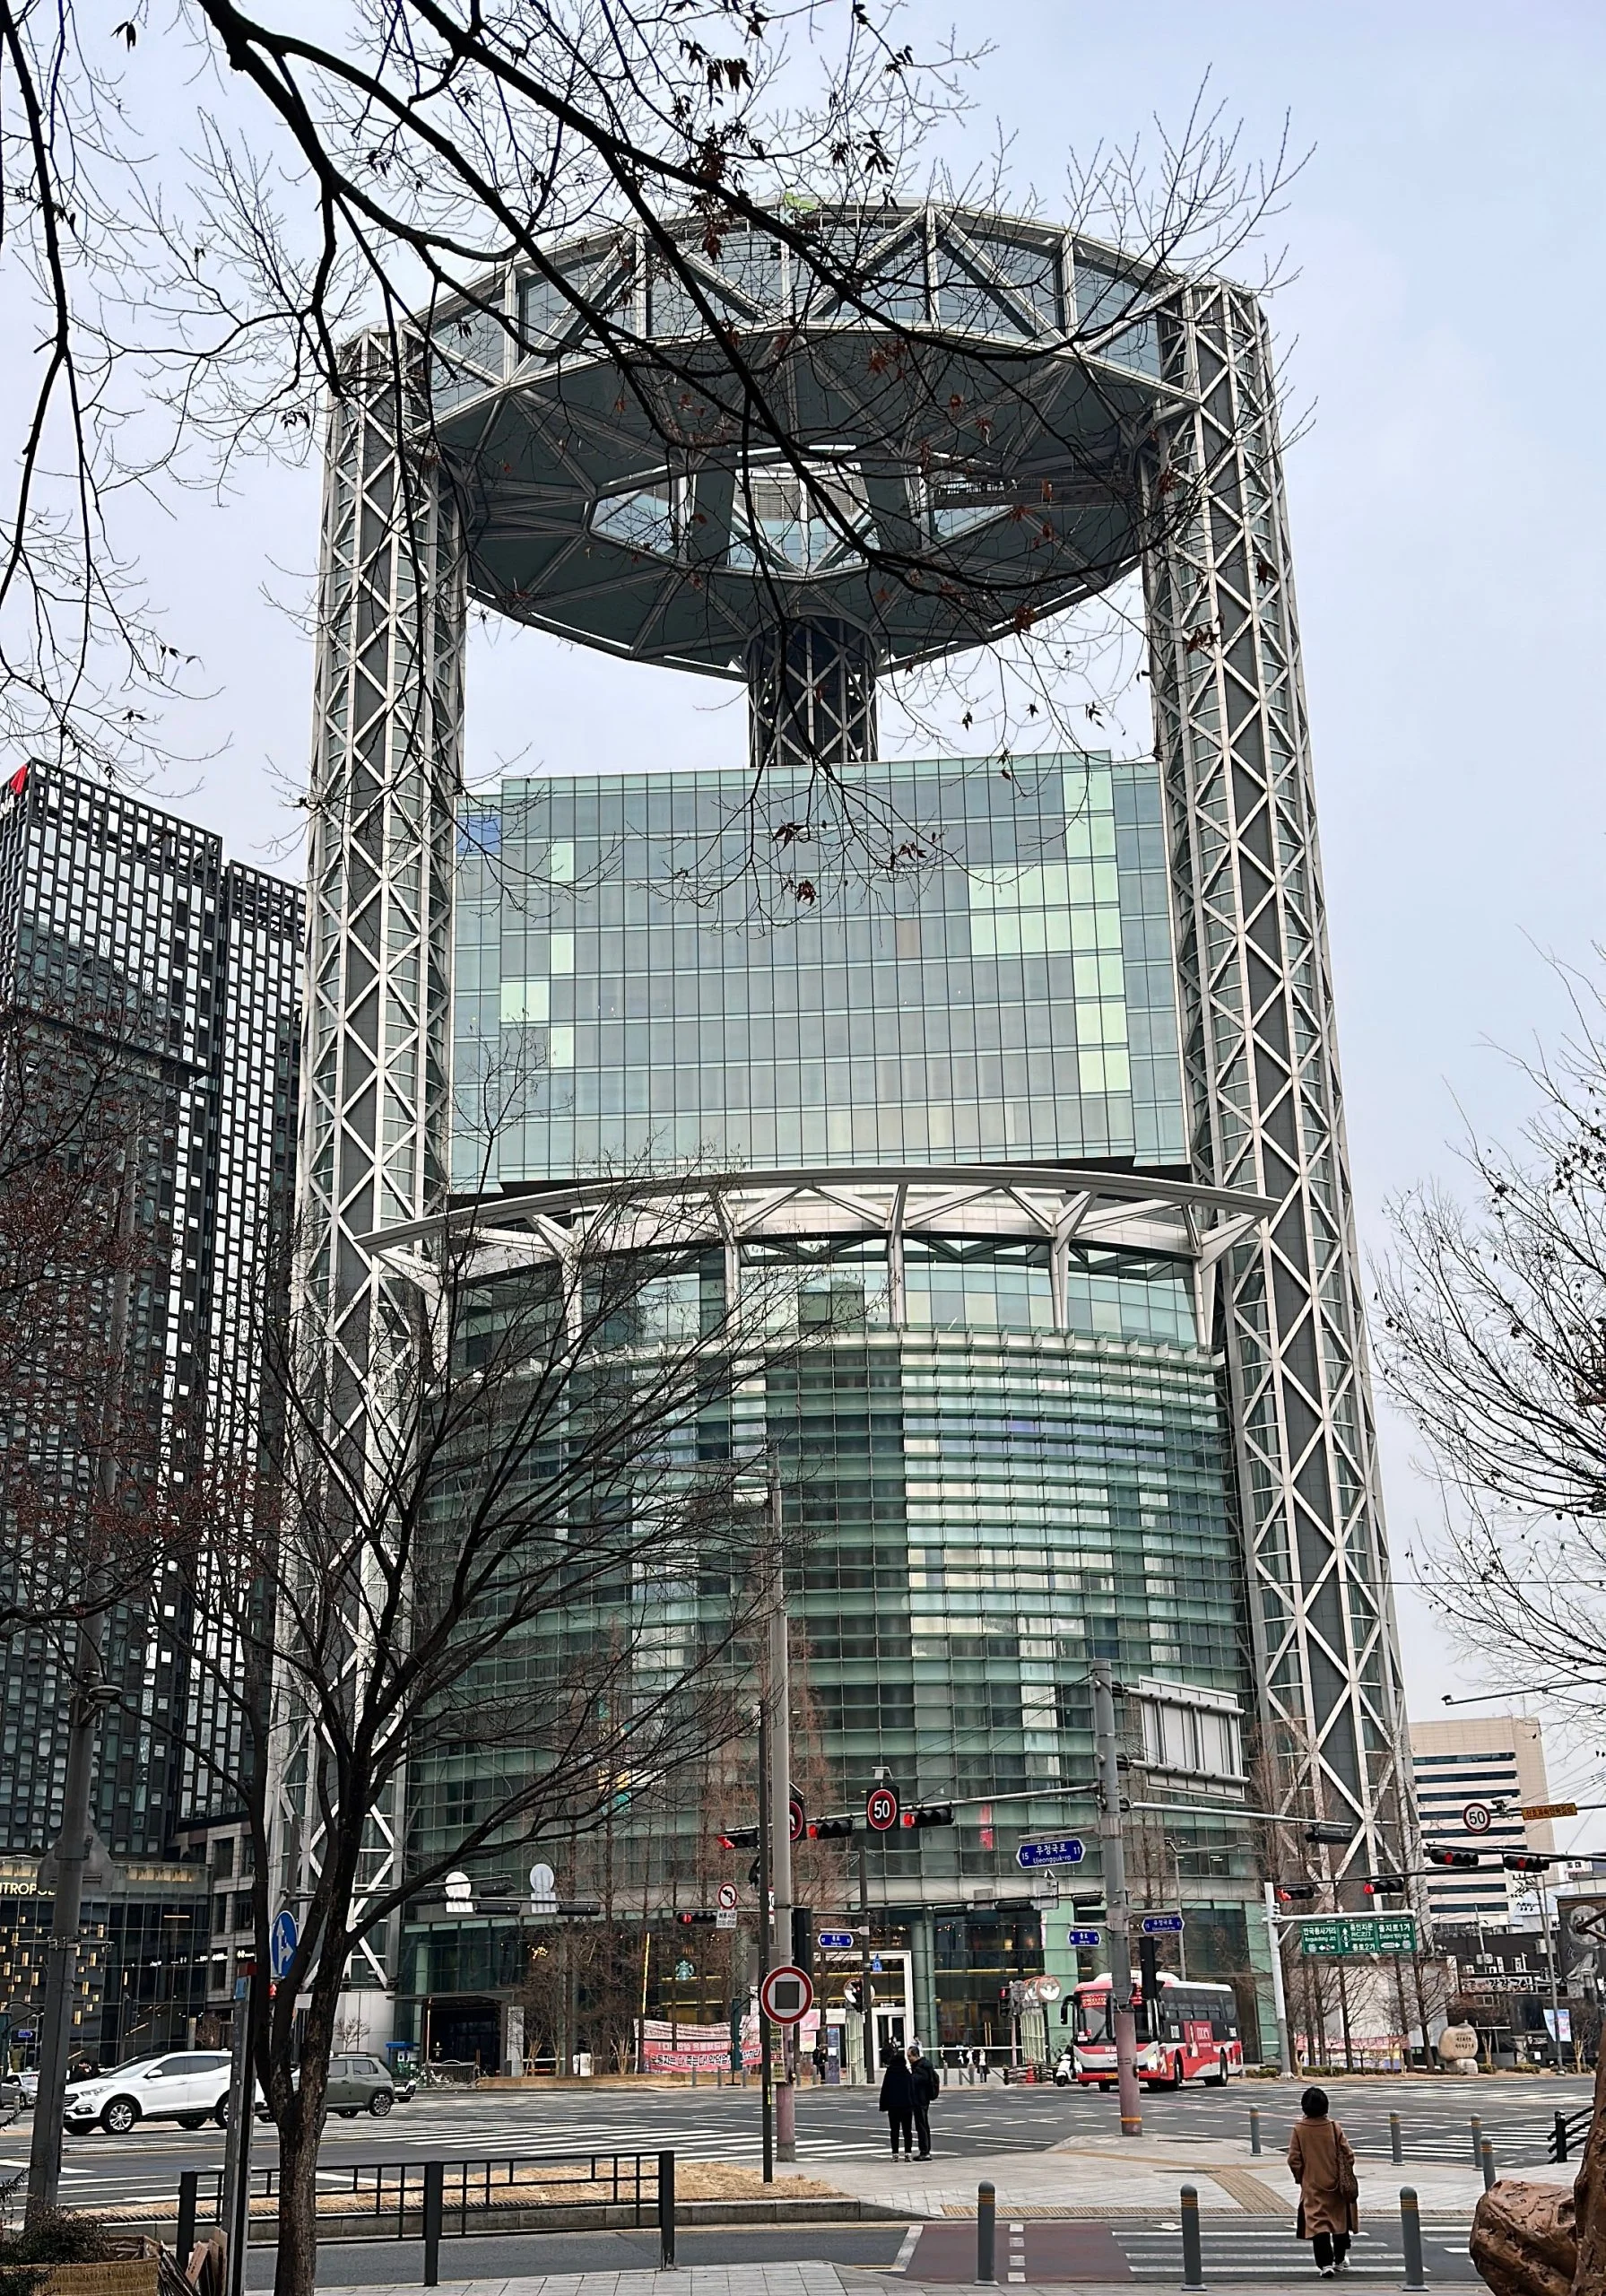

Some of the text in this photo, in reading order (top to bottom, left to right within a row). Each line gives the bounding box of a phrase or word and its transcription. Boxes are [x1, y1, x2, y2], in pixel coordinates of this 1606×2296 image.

[873, 1799, 890, 1820] 50
[1469, 1810, 1486, 1825] 50
[1036, 1843, 1067, 1857] 우정국로
[1073, 1846, 1081, 1855] 11
[1021, 1852, 1029, 1860] 15
[1032, 1855, 1072, 1865] Ujeongguk-ro
[1378, 1924, 1411, 1933] 을지로1가
